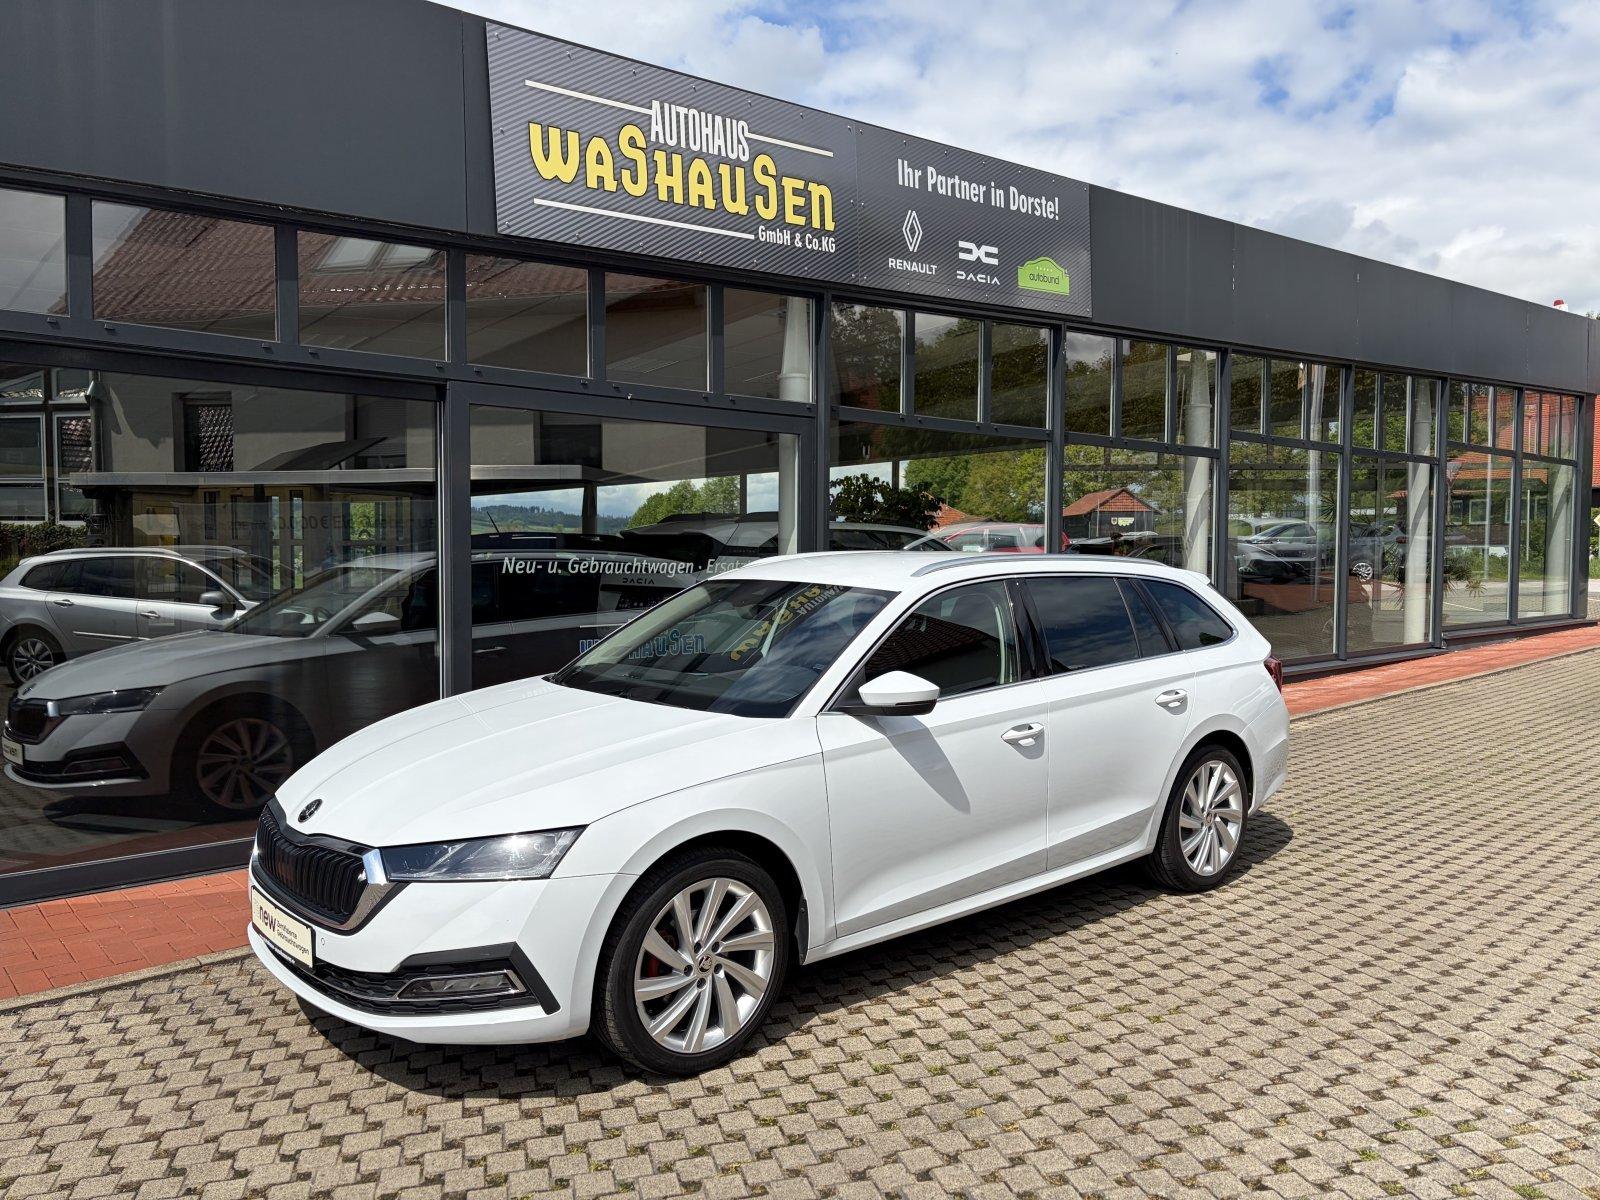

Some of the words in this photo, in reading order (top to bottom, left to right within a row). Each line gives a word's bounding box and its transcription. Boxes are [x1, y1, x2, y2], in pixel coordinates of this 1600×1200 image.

[651, 100, 749, 161] AUTOHAUS
[898, 158, 922, 189] Ihr
[927, 165, 987, 204] Partner
[991, 181, 1005, 208] in
[1010, 186, 1059, 221] Dorste!
[758, 225, 791, 246] GmbH
[794, 234, 803, 248] &
[805, 233, 836, 253] Co.KG
[888, 257, 938, 276] RENAULT
[957, 270, 1000, 286] DACIA
[1028, 272, 1060, 285] autobund
[502, 556, 543, 575] Neu-
[547, 559, 563, 575] u.
[568, 556, 694, 579] Gebrauchtwagen
[622, 577, 655, 585] DACIA
